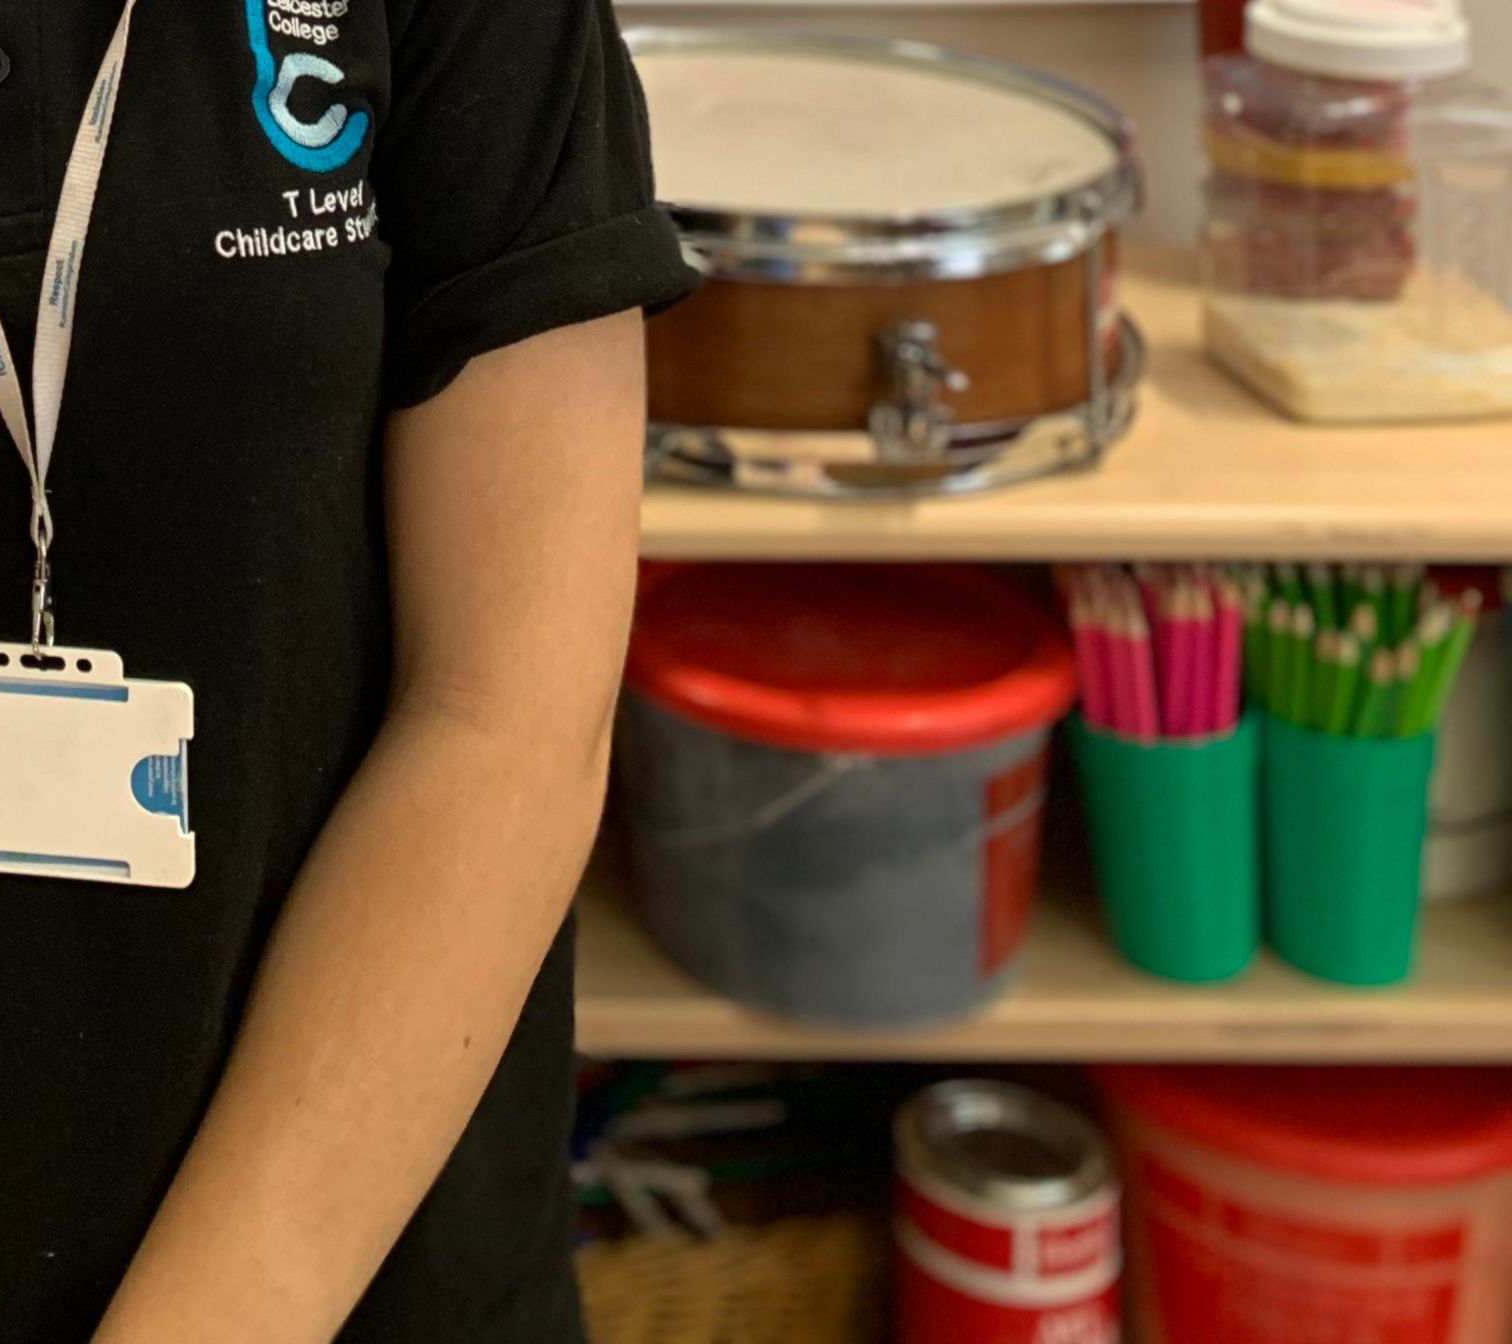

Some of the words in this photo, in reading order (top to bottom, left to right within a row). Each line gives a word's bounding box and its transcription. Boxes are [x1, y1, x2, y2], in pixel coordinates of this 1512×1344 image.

[268, 10, 340, 45] College
[282, 190, 300, 218] T
[309, 180, 364, 216] Level
[215, 227, 338, 258] Childcare
